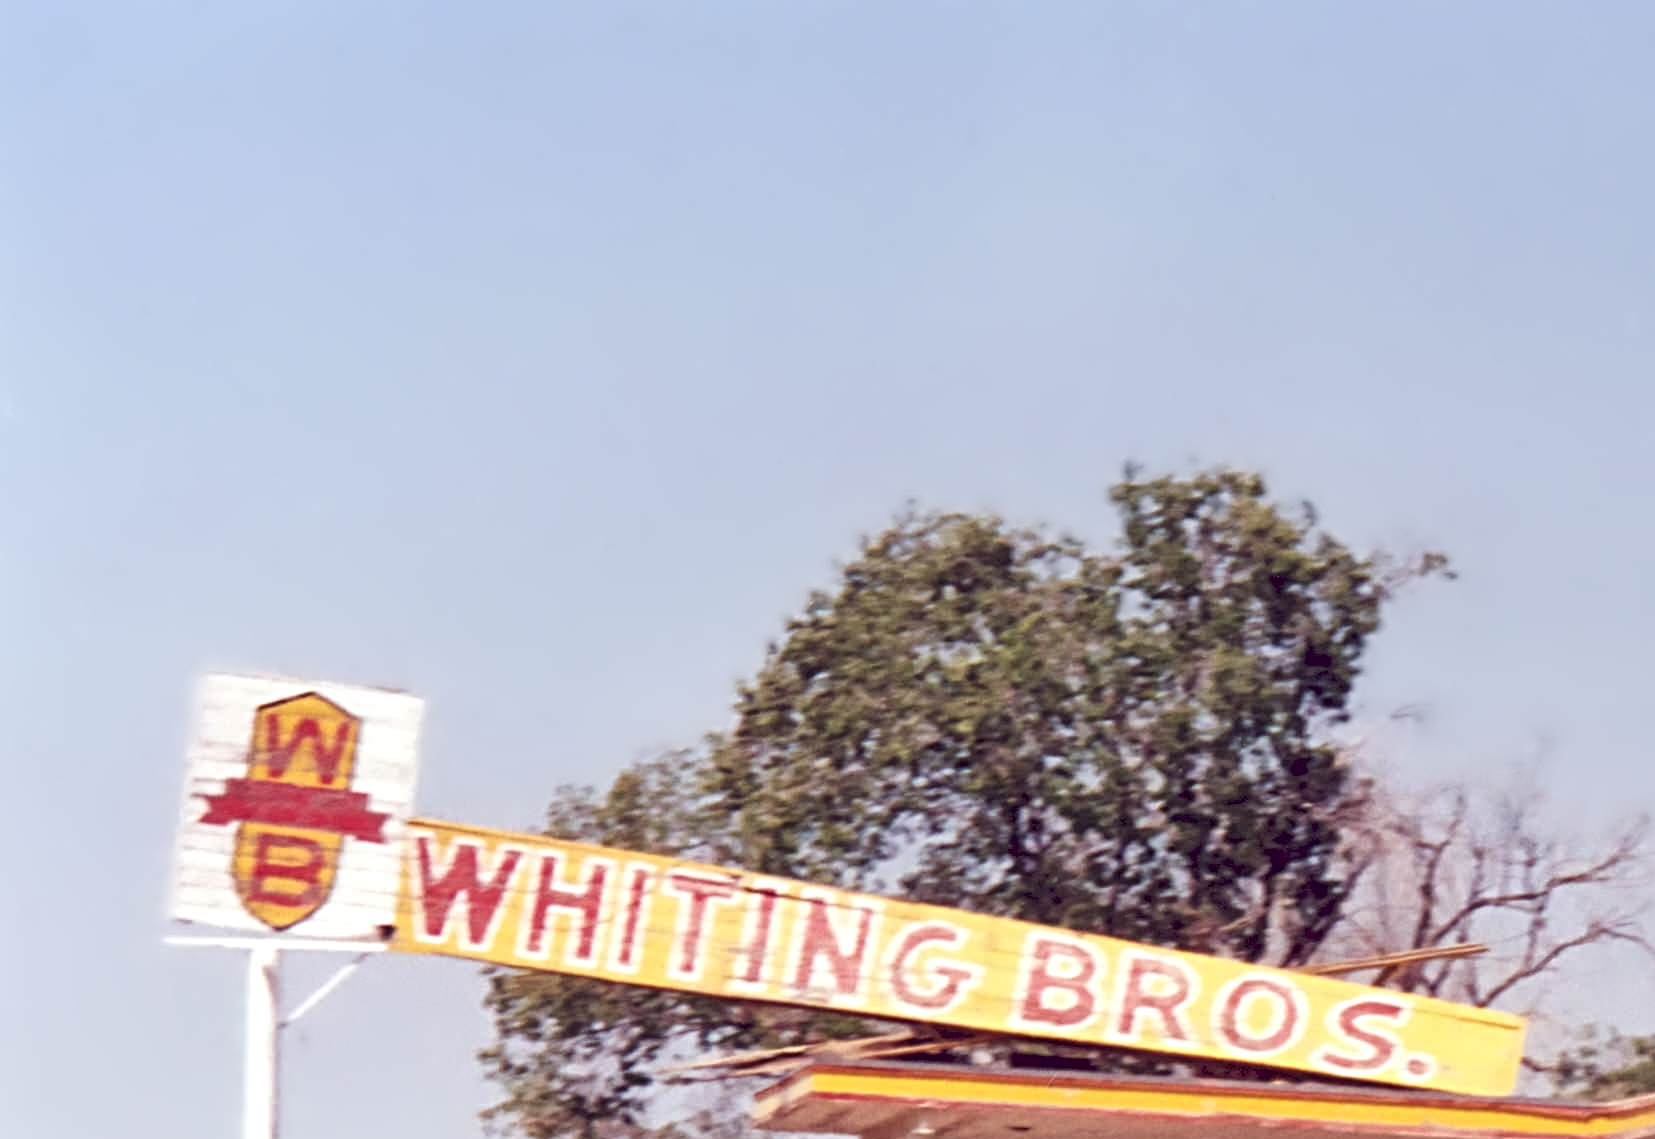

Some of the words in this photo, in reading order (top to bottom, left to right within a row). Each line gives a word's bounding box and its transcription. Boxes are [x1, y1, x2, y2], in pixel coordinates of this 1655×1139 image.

[264, 712, 350, 785] W
[246, 831, 324, 907] B
[416, 834, 972, 1008] WHITING
[1019, 937, 1430, 1076] BROS.
